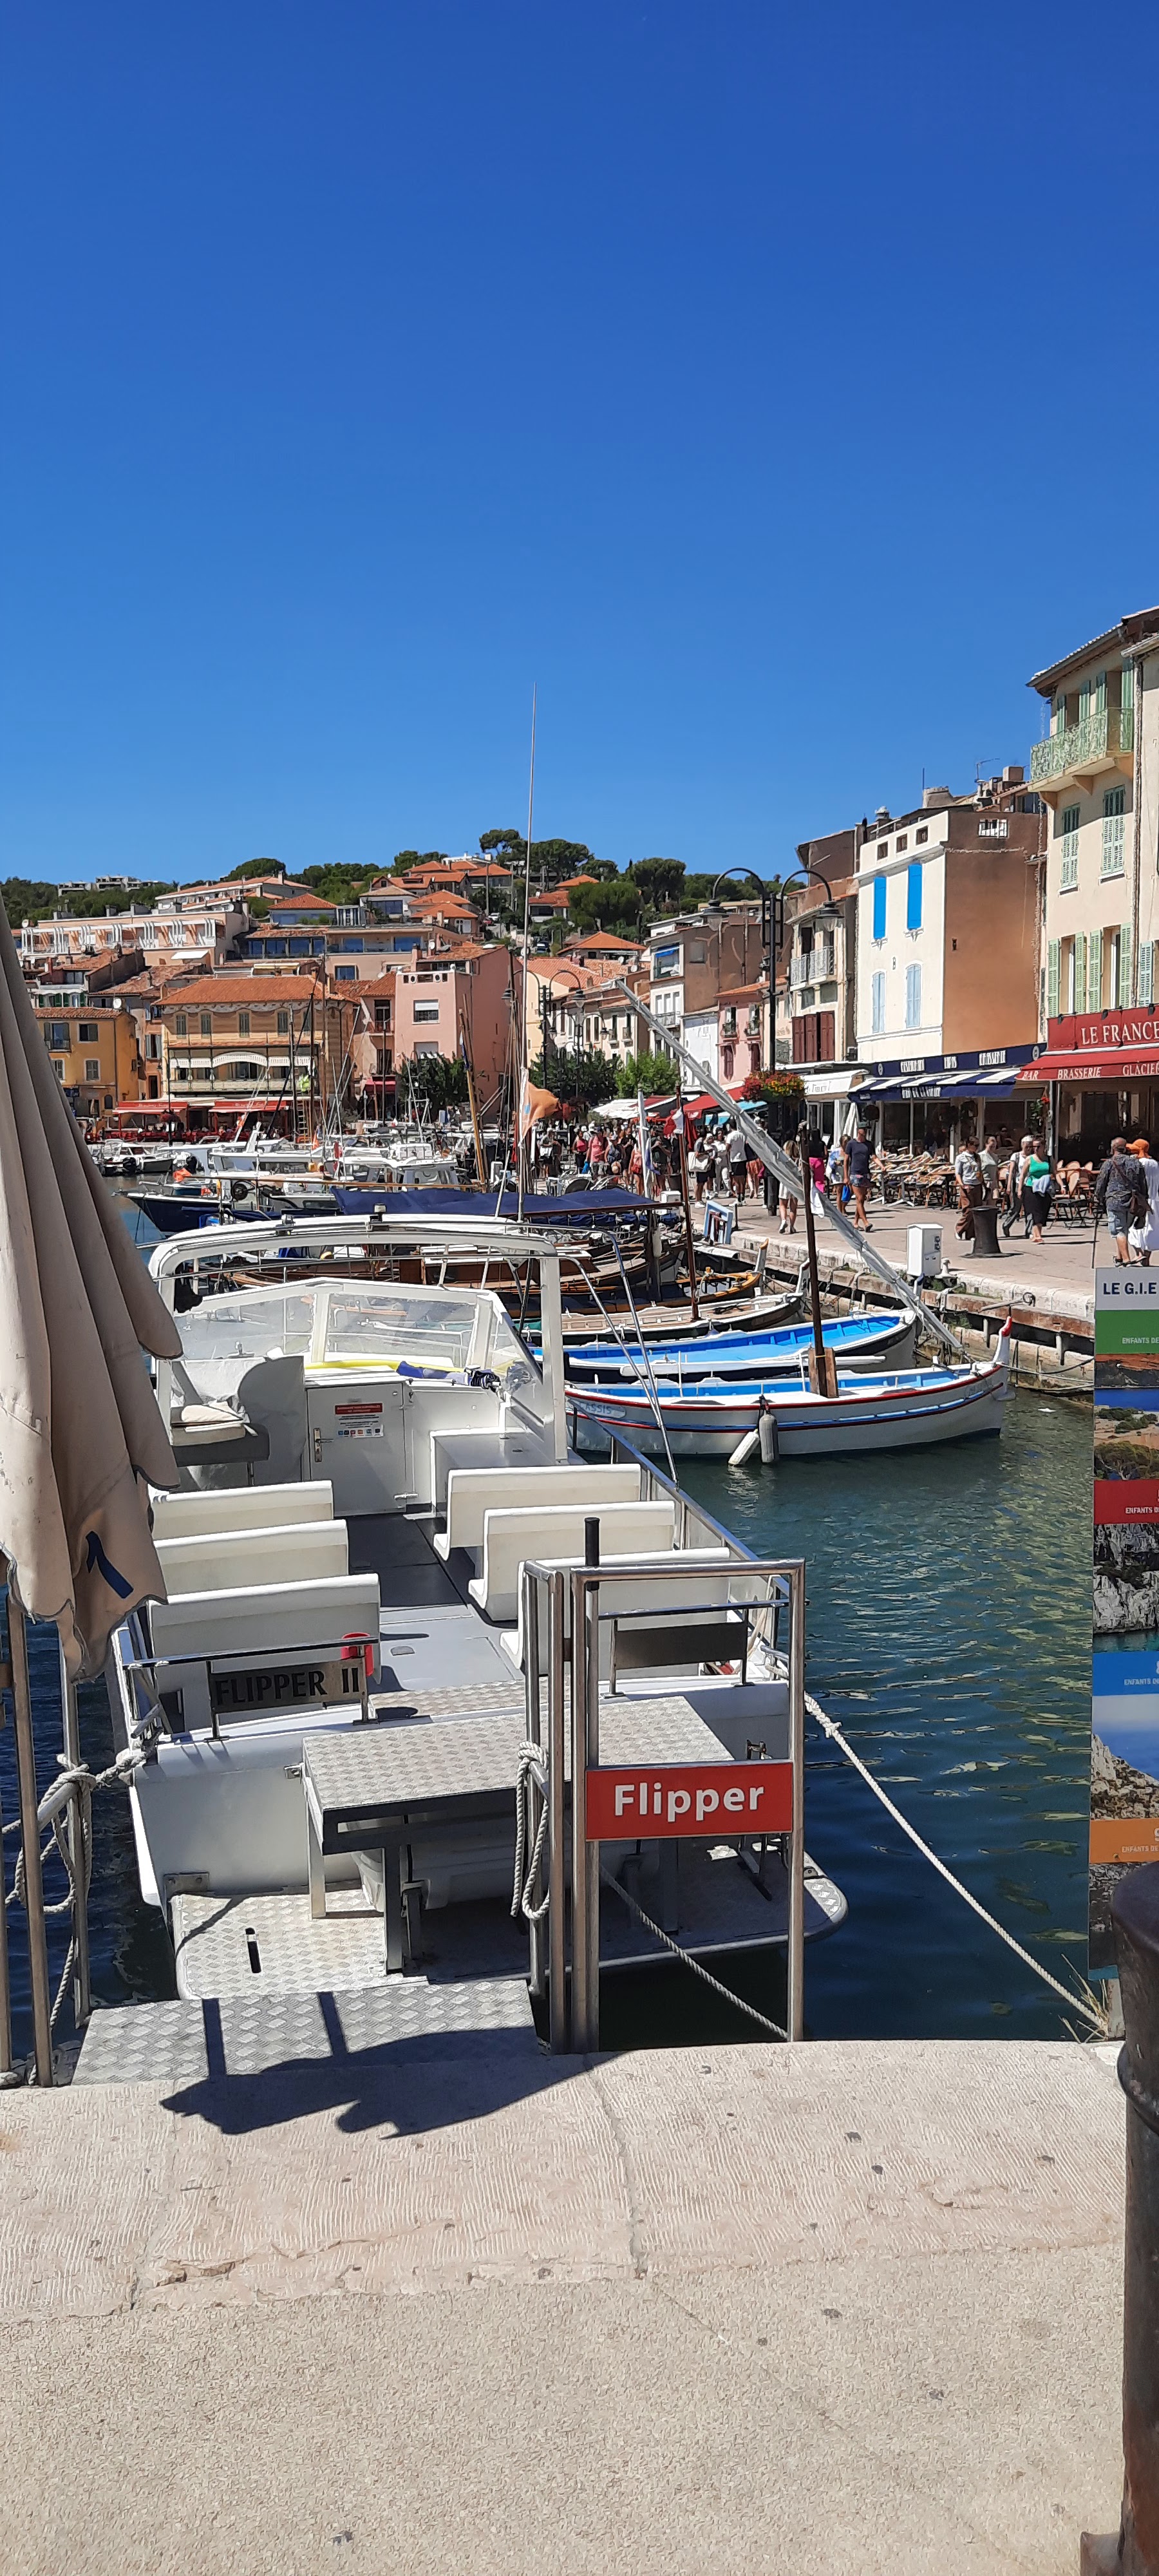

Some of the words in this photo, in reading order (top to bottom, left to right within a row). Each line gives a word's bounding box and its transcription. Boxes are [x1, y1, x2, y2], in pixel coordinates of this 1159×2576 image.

[1081, 1027, 1098, 1045] LE
[1022, 1070, 1039, 1080] BAR
[1057, 1066, 1102, 1079] BRASSERIE
[1103, 1282, 1120, 1295] LE
[216, 1670, 329, 1705] FLIPPER
[341, 1667, 359, 1693] II
[614, 1782, 765, 1823] Flipper
